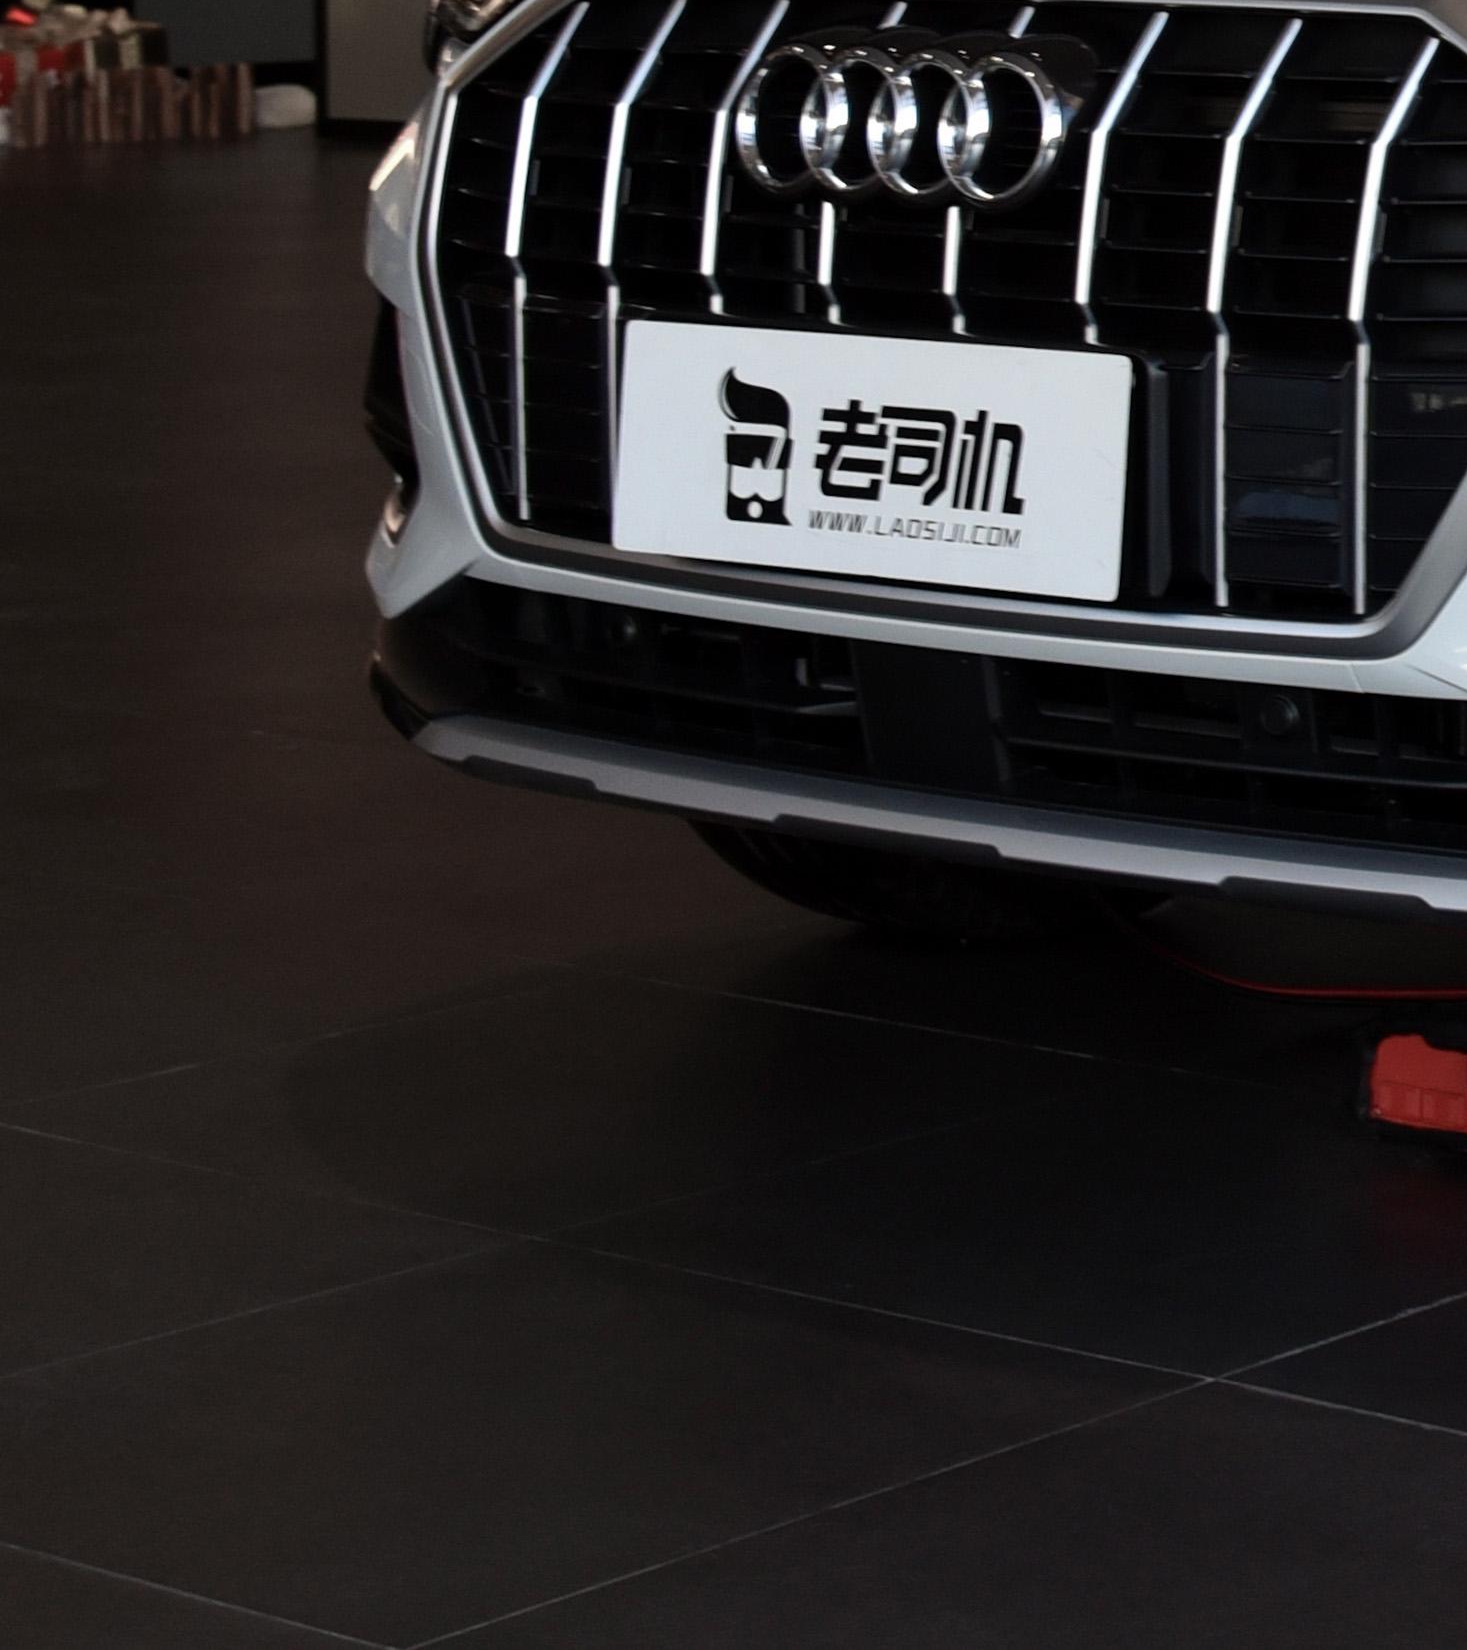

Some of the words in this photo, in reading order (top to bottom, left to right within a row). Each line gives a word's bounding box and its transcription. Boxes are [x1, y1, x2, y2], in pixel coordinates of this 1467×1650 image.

[814, 399, 1026, 515] 老司机
[807, 509, 1022, 550] WWW.LAOSIJI.COM
